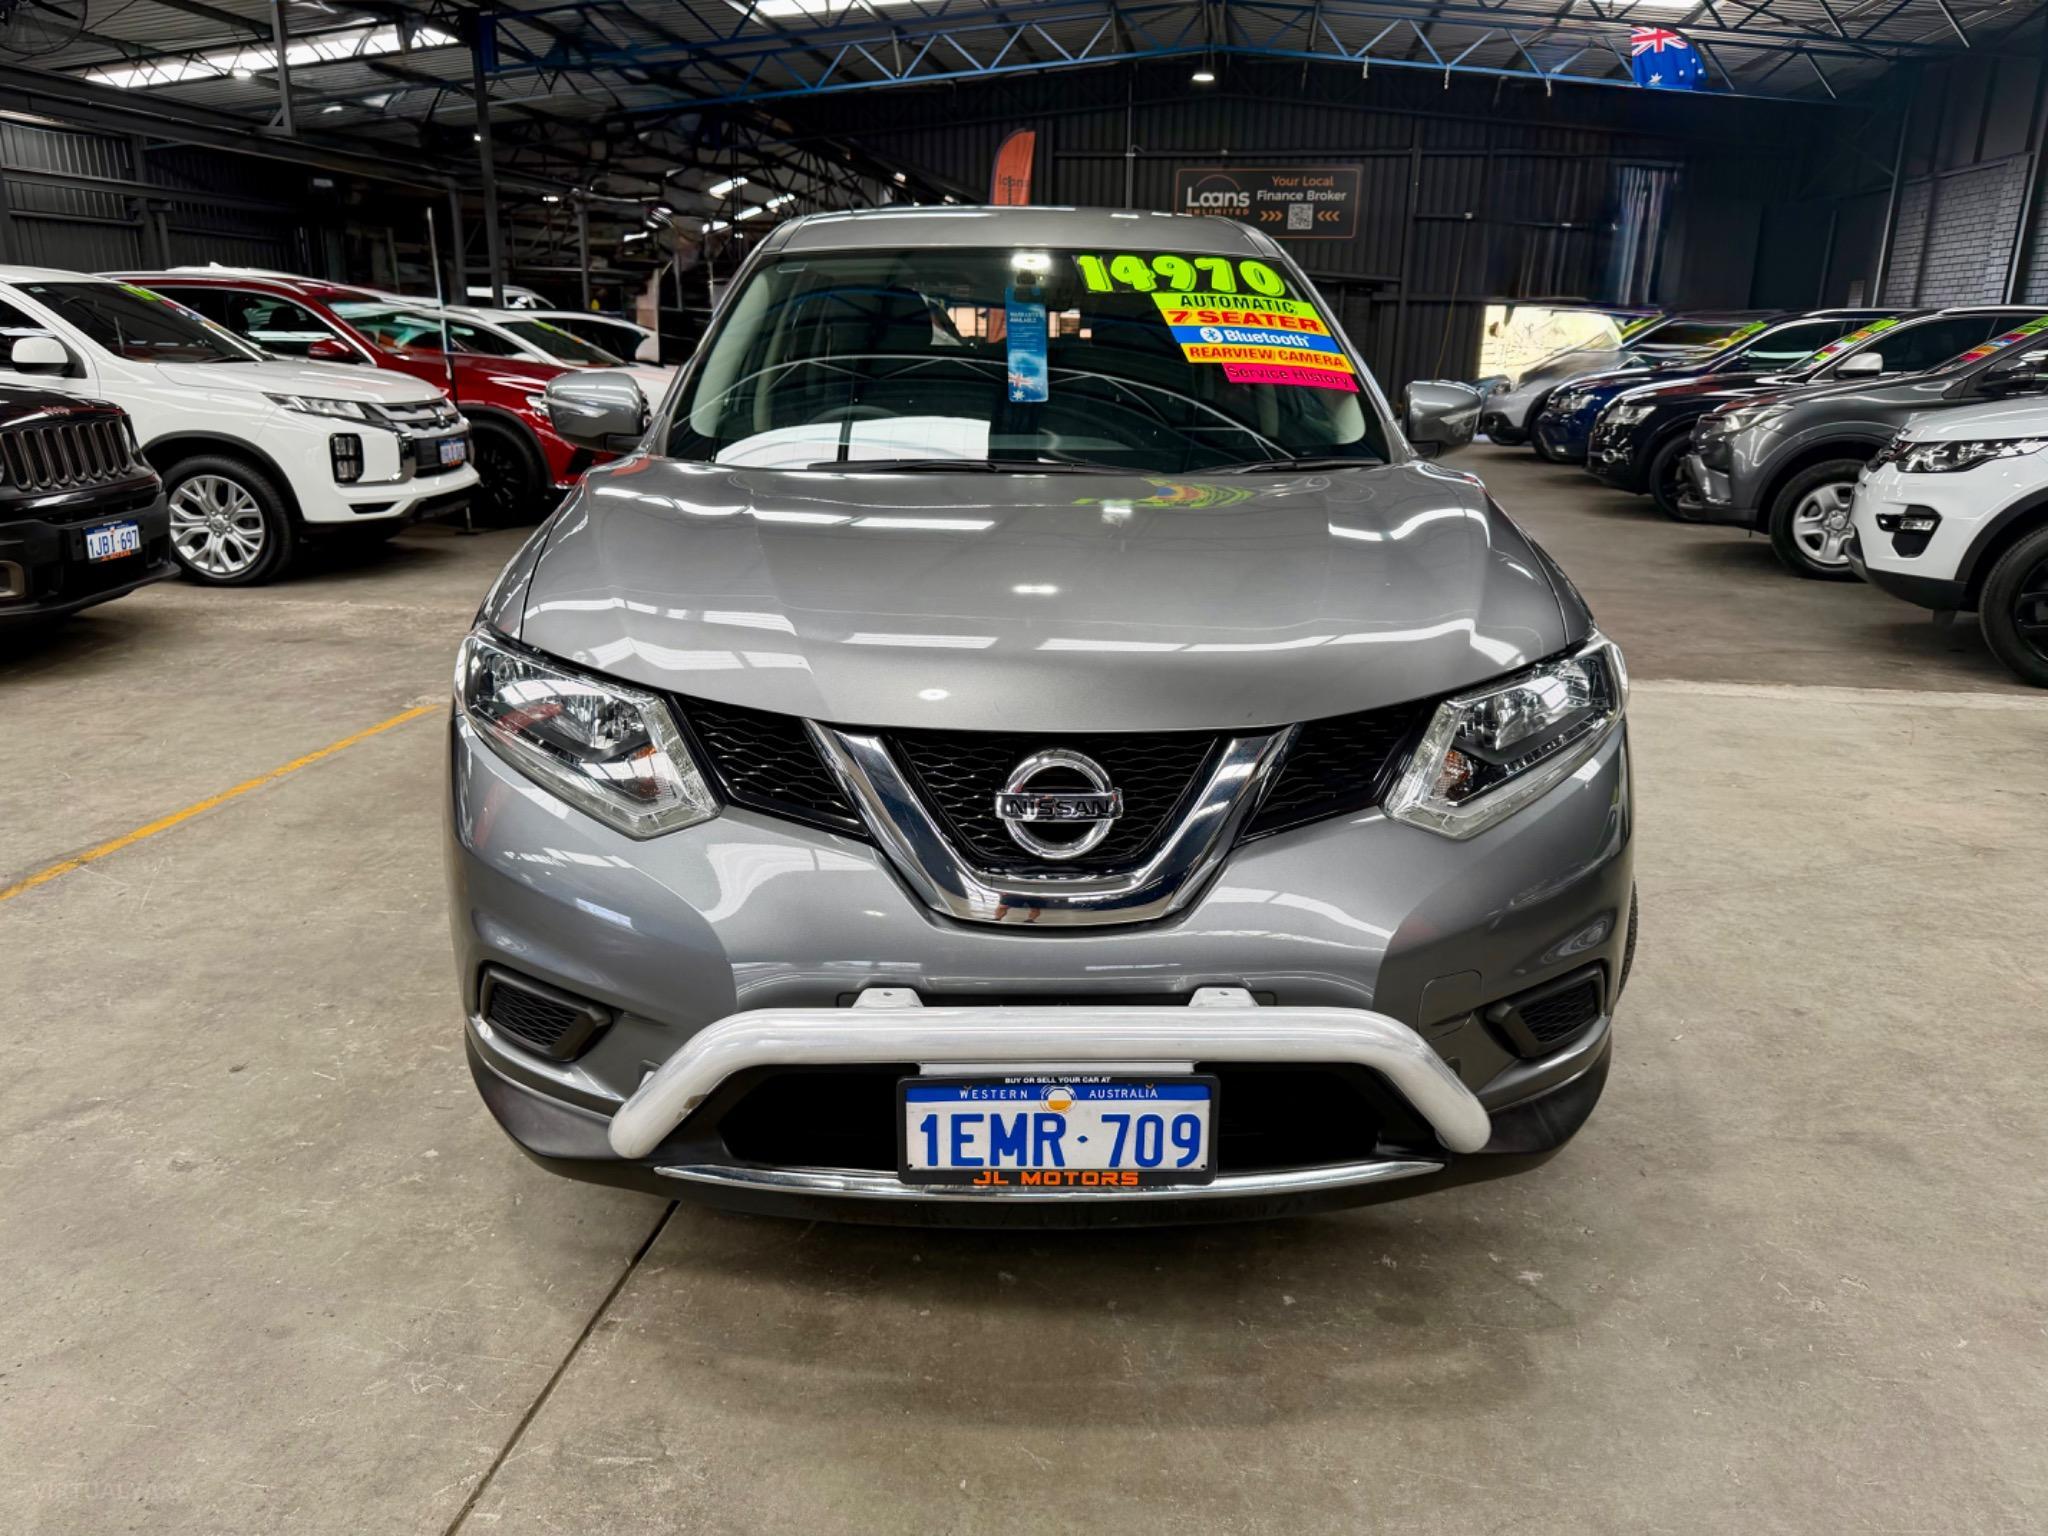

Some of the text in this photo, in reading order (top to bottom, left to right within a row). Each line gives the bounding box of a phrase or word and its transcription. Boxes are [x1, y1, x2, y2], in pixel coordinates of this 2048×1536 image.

[1271, 175, 1334, 187] Your Local
[1186, 186, 1250, 208] Loans
[1256, 190, 1347, 202] Finance Broker
[1077, 255, 1286, 297] 14970
[1180, 295, 1296, 314] AUTOMATIC
[1168, 311, 1321, 333] 7 SEATER
[1223, 329, 1310, 348] Bluetooth
[1189, 347, 1345, 368] REARVIEW CAMERA
[1227, 366, 1350, 388] Service History
[1006, 799, 1111, 817] NISSAN
[1036, 1076, 1056, 1084] SELL
[1058, 1076, 1081, 1084] YOUR
[1082, 1076, 1100, 1084] CAR
[1100, 1076, 1112, 1084] AT
[959, 1088, 1158, 1100] WESTERN AUSTRALIA
[973, 1171, 1139, 1186] JL MOTORS
